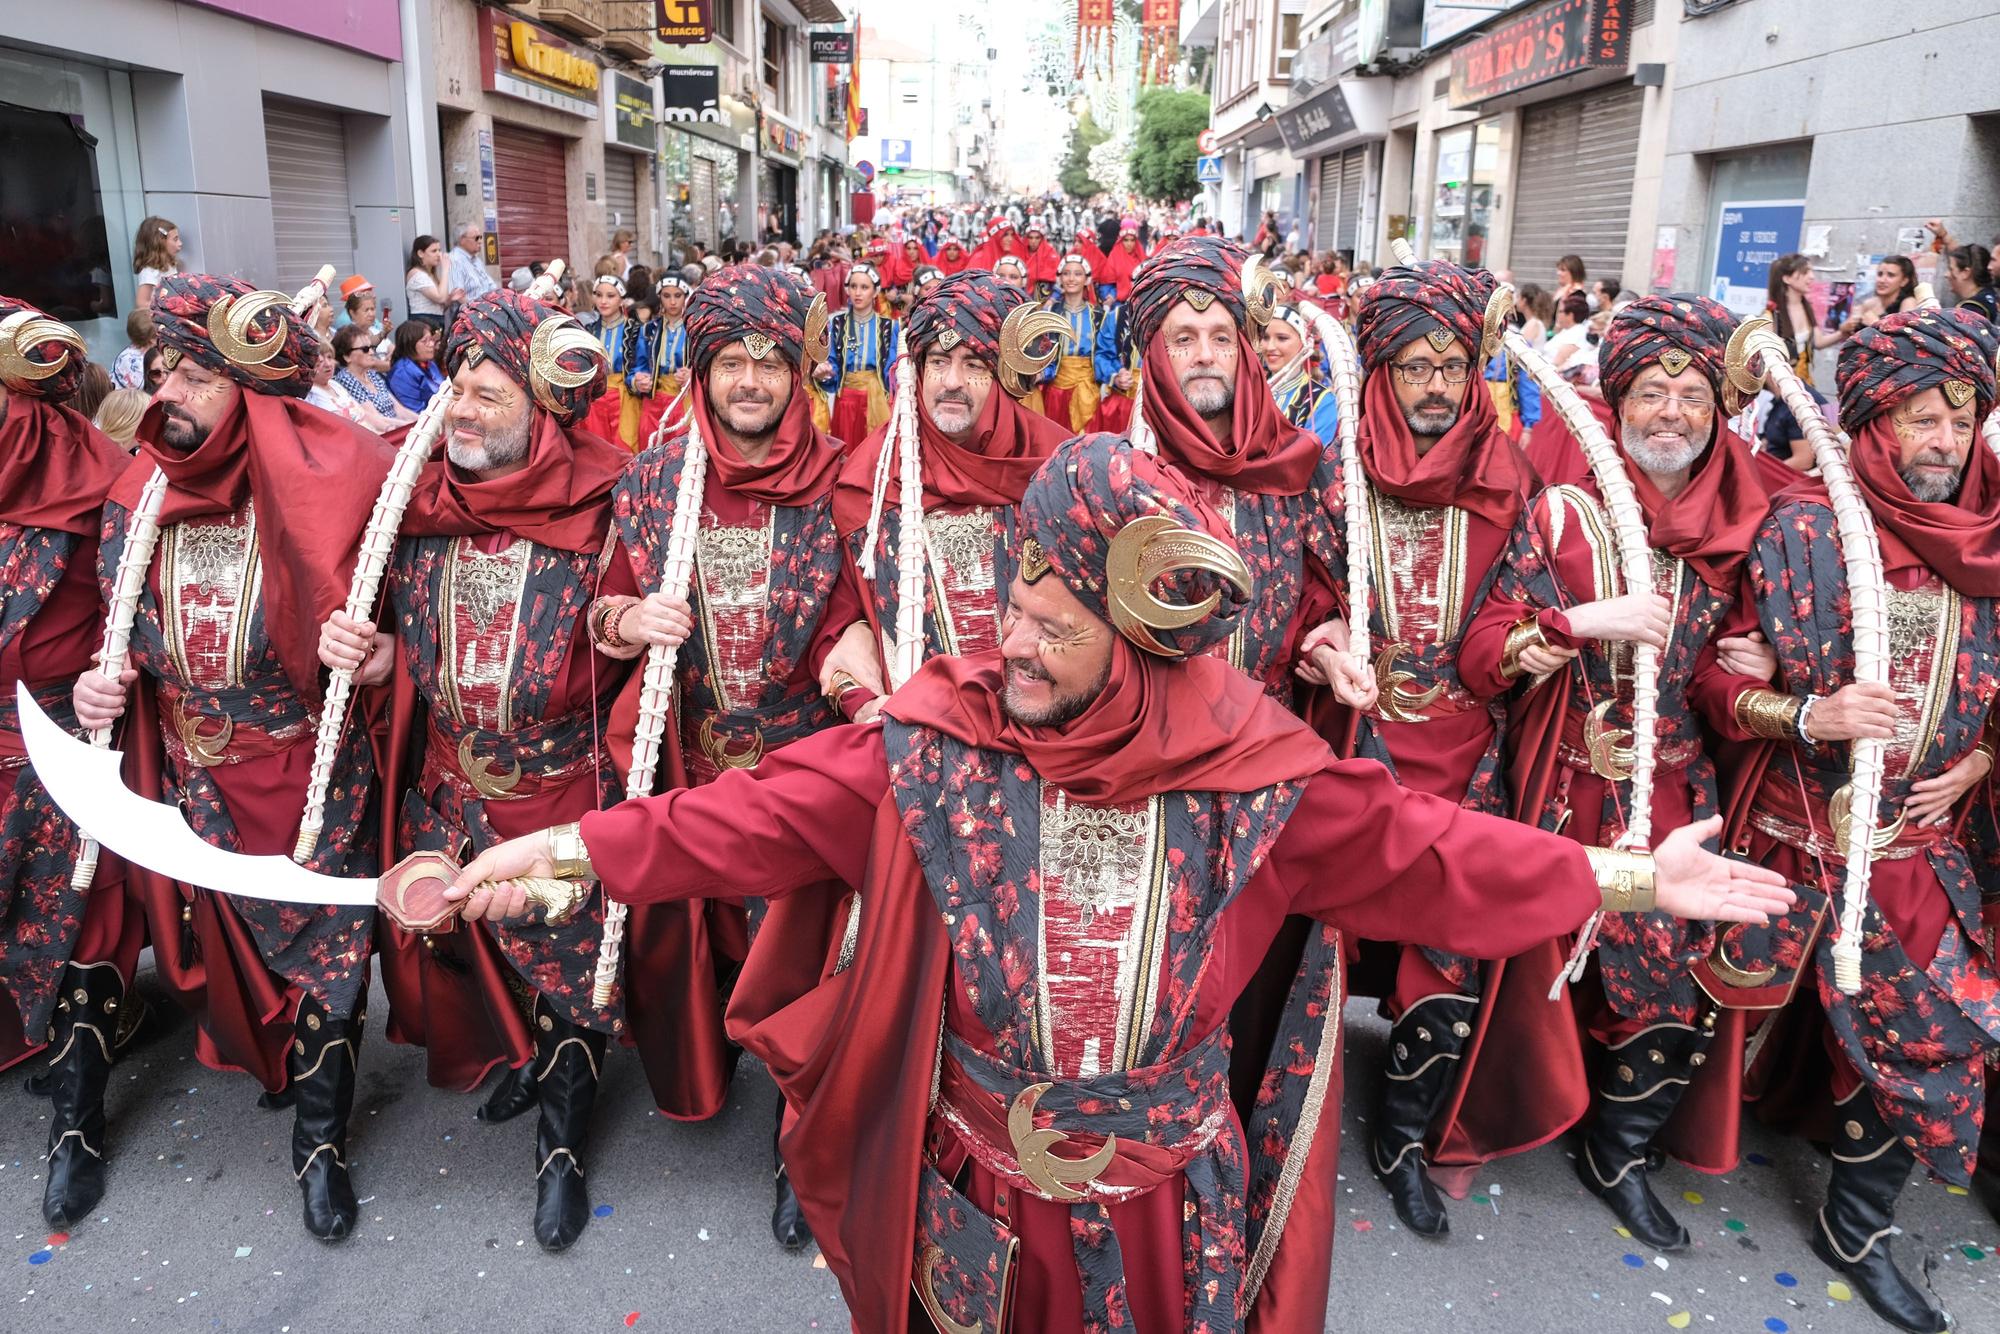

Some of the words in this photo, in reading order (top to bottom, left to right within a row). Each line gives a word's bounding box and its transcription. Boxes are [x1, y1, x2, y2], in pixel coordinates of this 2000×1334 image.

[660, 27, 705, 36] TABACOS
[1467, 21, 1566, 89] FARO'S
[888, 139, 906, 161] P
[1739, 231, 1751, 243] SE
[1753, 231, 1778, 243] VENDE
